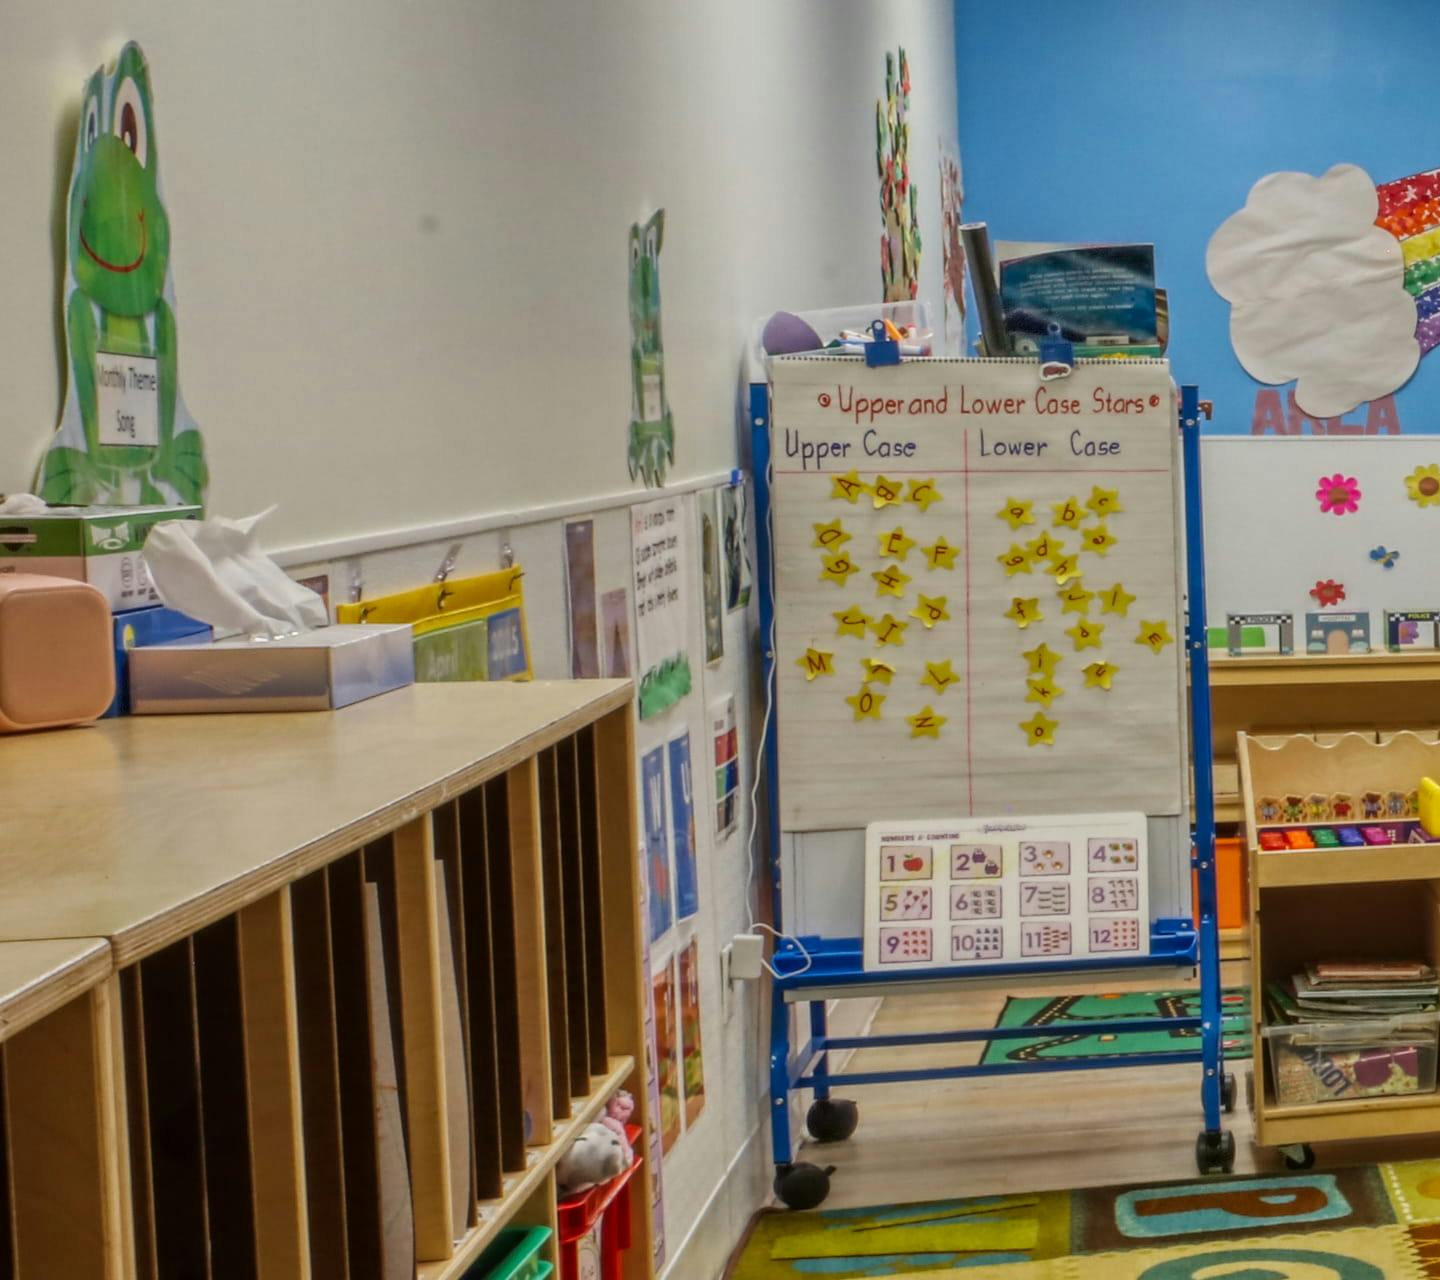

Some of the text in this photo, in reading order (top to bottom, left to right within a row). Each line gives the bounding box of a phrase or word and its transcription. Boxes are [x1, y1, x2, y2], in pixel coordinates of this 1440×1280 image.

[837, 384, 1146, 424] Upper and Lower Case Stars
[785, 427, 918, 471] Upper Case
[978, 427, 1122, 458] Lower Case
[835, 477, 862, 498] A
[875, 484, 897, 502] B
[1062, 502, 1076, 522] b
[887, 532, 903, 555] E
[1035, 537, 1049, 557] d
[933, 544, 949, 564] F
[878, 573, 900, 590] H
[1406, 611, 1432, 621] POLICE
[805, 652, 828, 674] M
[955, 853, 972, 872] 2
[1023, 845, 1038, 864] 3
[1092, 845, 1108, 863] 4
[886, 855, 896, 873] 1
[884, 894, 899, 913] 5
[954, 892, 969, 911] 6
[1023, 886, 1039, 904] 7
[1091, 886, 1106, 905] 8
[886, 936, 901, 954] 9
[952, 934, 976, 952] 10
[1025, 932, 1044, 950] 11
[1091, 929, 1112, 946] 12
[1133, 1185, 1327, 1220] P
